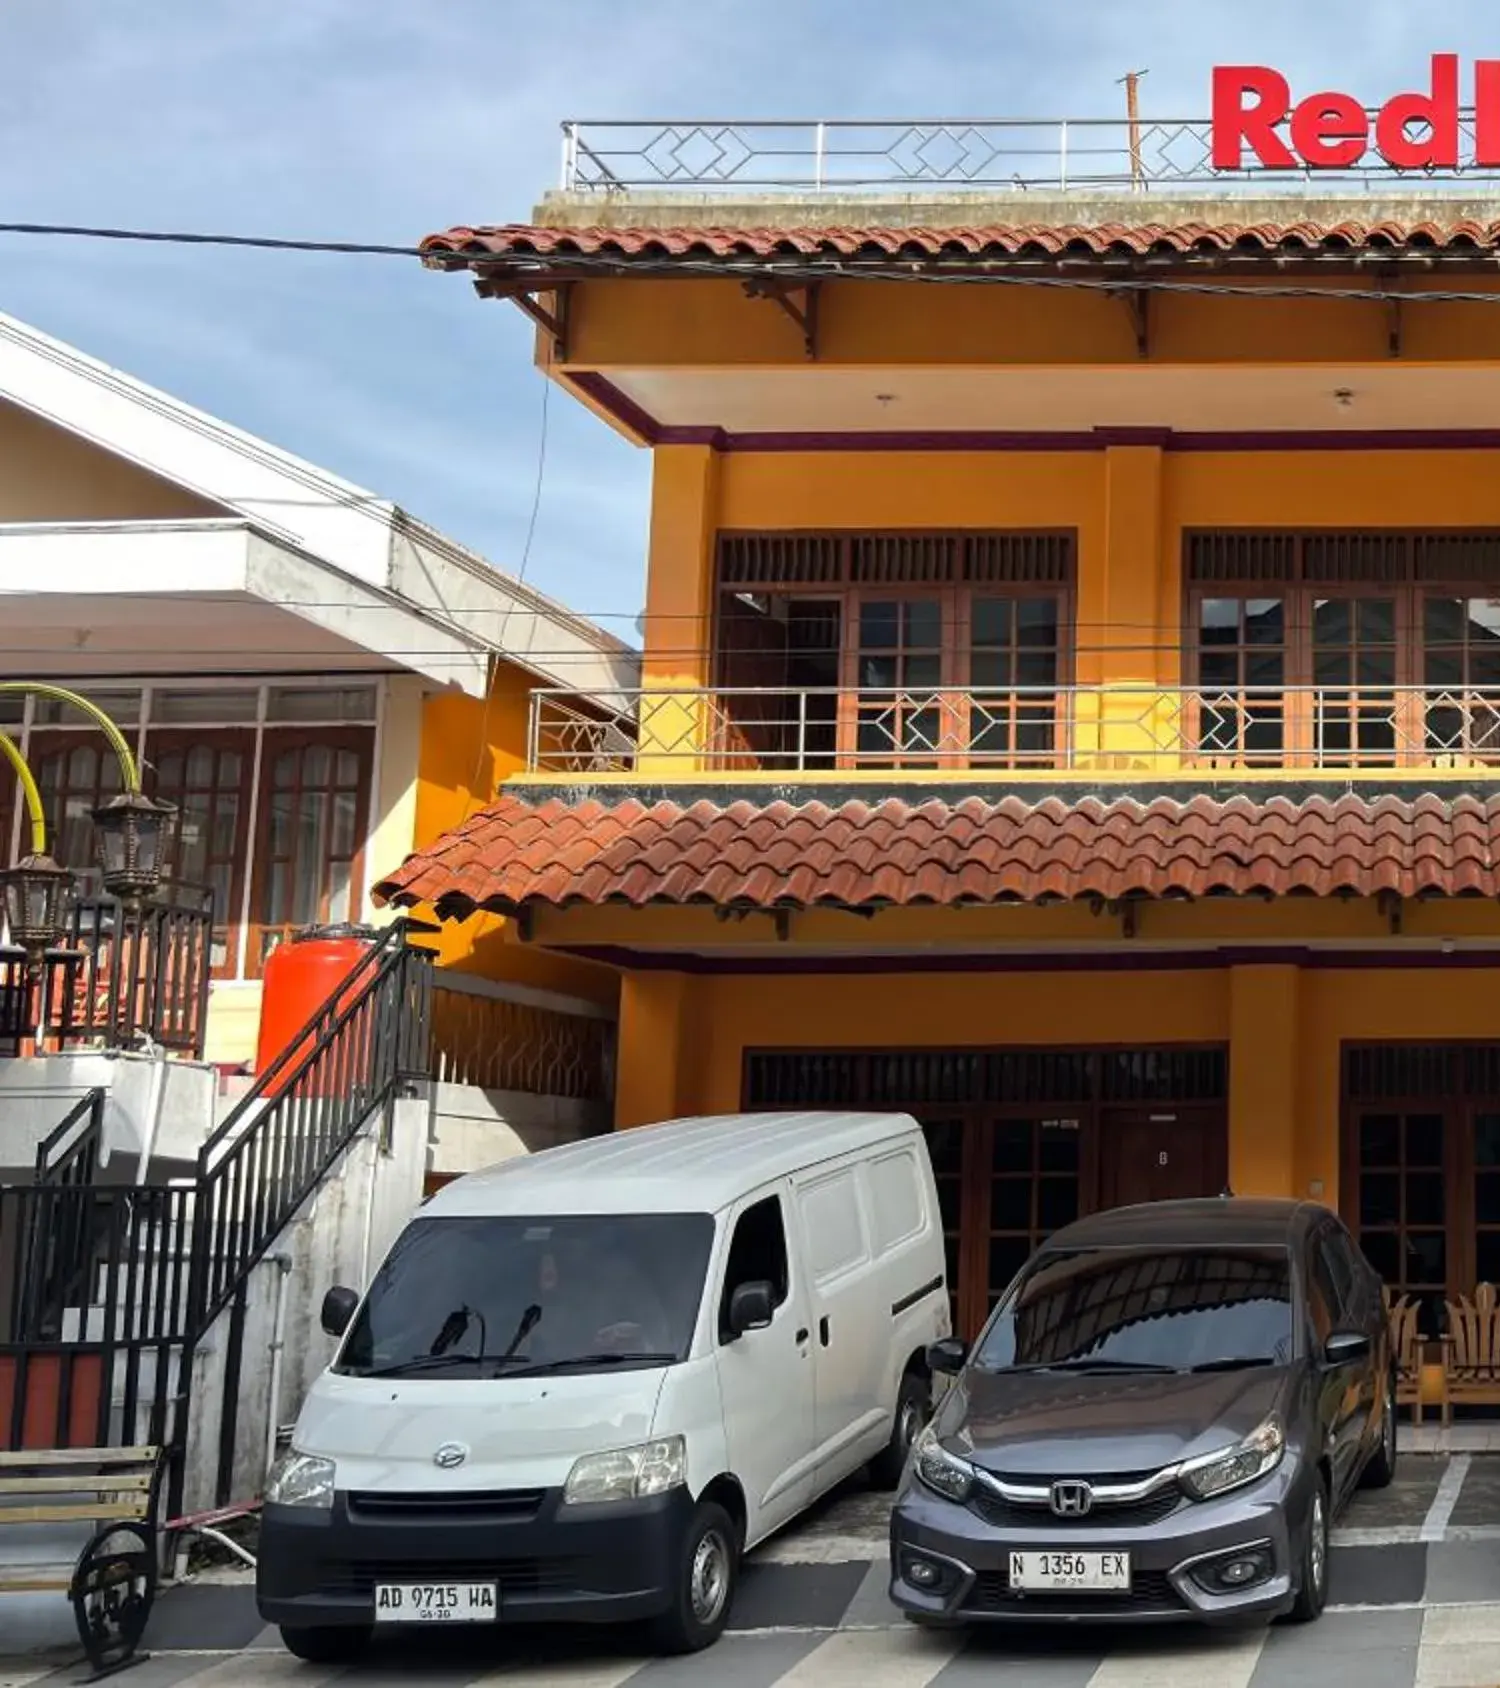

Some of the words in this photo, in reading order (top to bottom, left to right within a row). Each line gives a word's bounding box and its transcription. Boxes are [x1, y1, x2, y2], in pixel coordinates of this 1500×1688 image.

[1013, 1555, 1024, 1575] N
[1040, 1555, 1086, 1575] 1356
[1101, 1555, 1125, 1576] EX
[378, 1587, 403, 1608] AD
[412, 1587, 458, 1608] 9715
